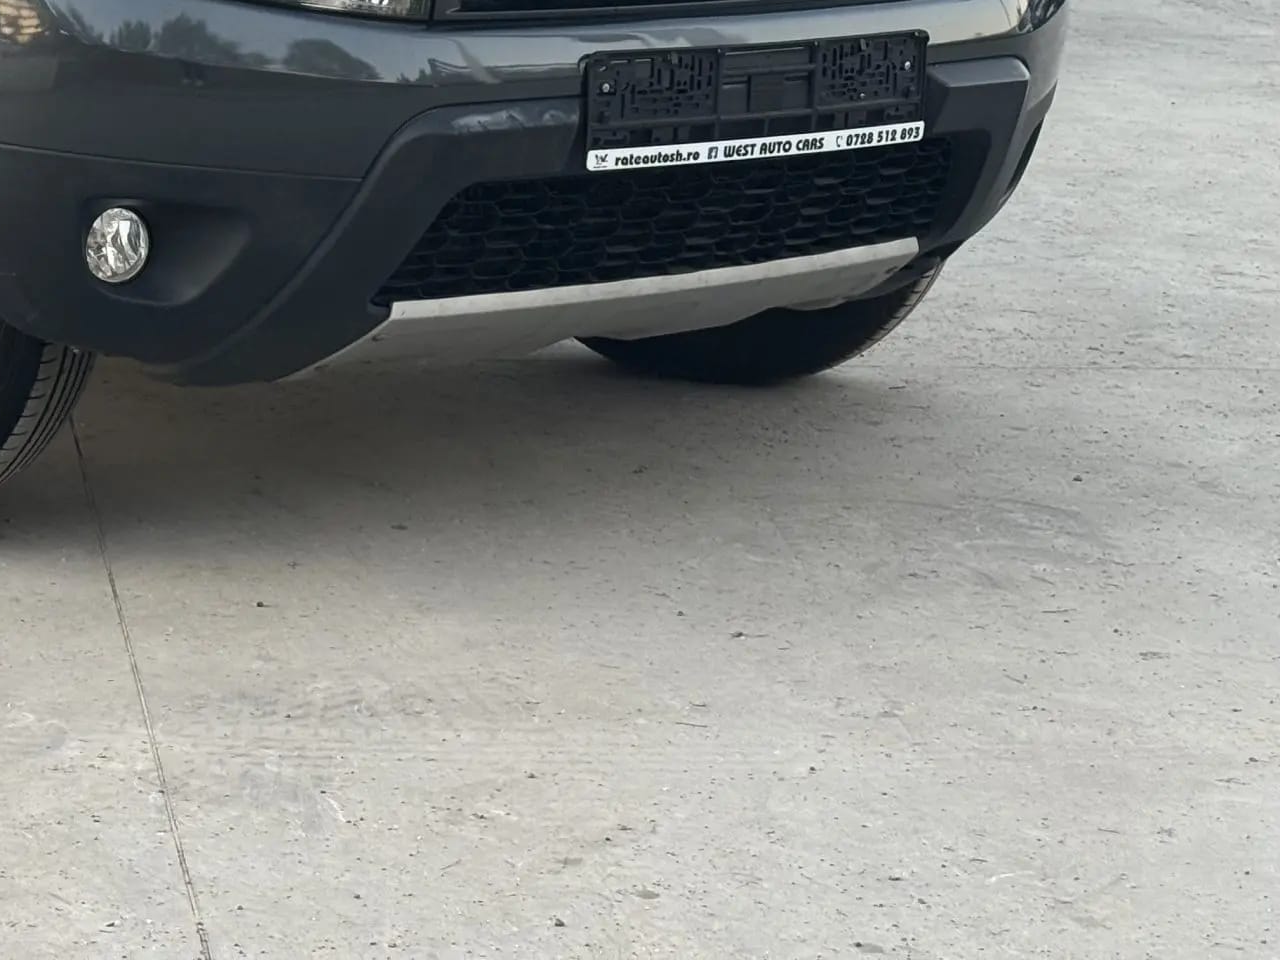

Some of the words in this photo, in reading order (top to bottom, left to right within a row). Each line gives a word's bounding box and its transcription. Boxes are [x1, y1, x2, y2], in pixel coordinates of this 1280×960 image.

[614, 150, 700, 166] rateautosh.ro
[723, 144, 757, 158] WEST
[759, 140, 792, 155] AUTO
[795, 137, 825, 151] CARS
[846, 132, 874, 147] 0728
[876, 129, 897, 143] 512
[899, 126, 921, 140] 893
